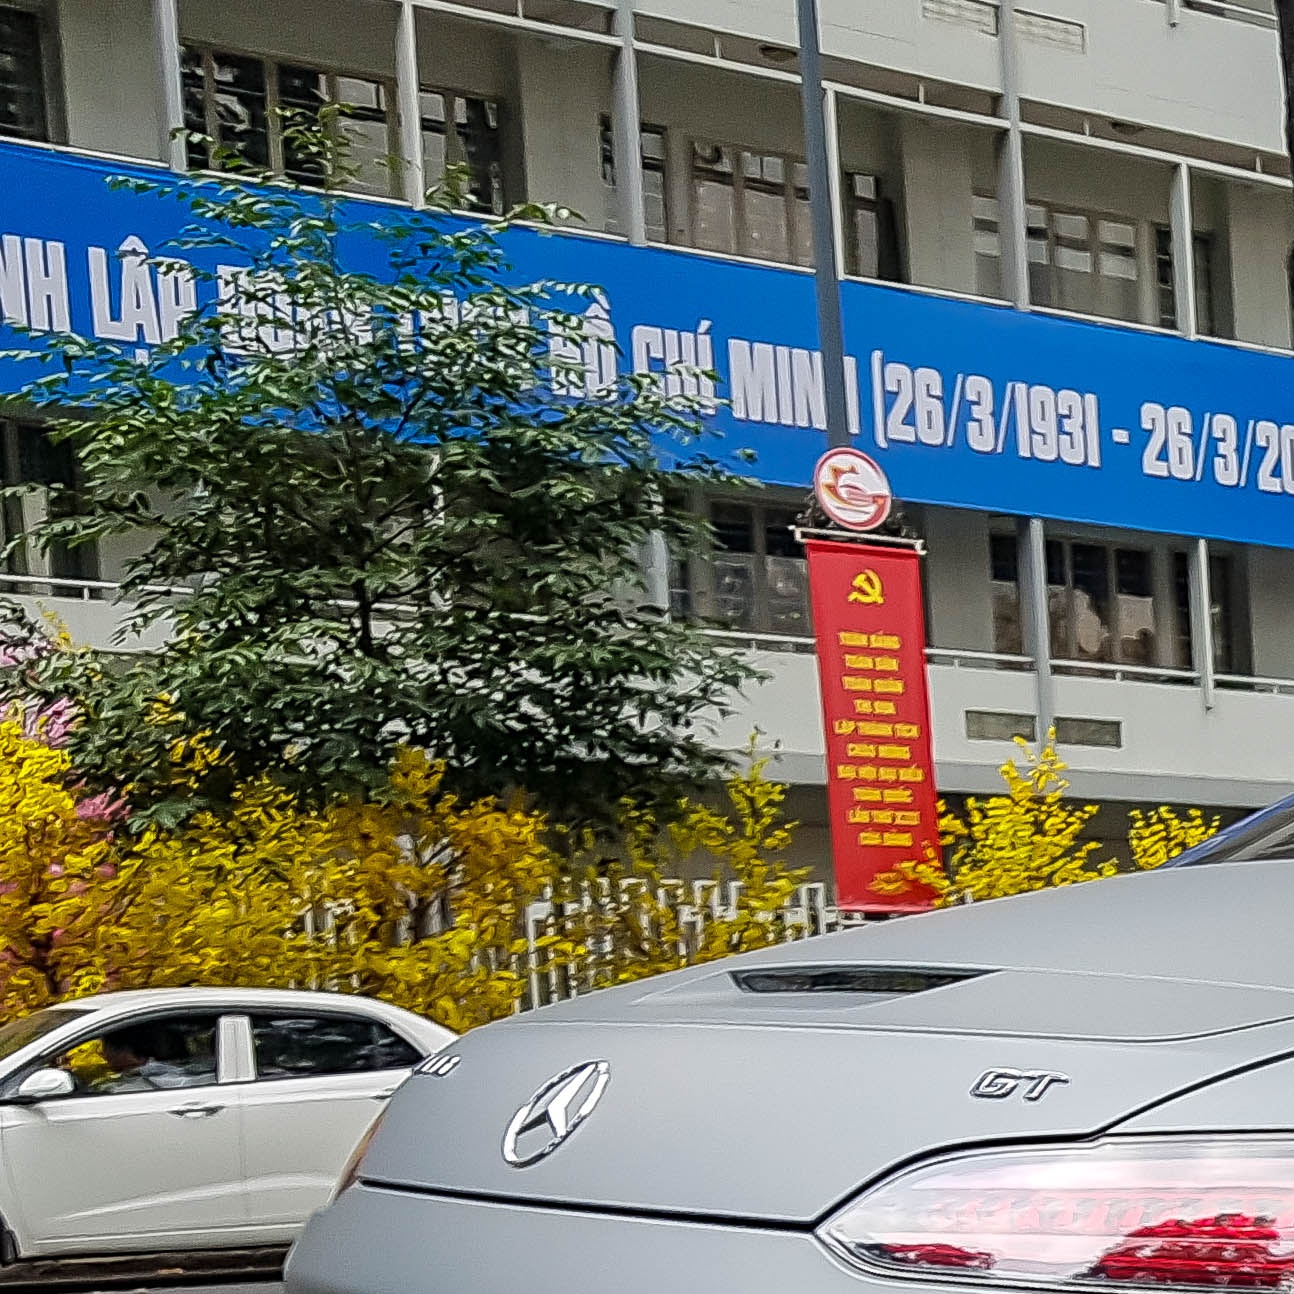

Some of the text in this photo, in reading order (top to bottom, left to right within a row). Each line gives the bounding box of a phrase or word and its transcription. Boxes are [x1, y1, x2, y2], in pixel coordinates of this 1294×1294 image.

[88, 235, 197, 366] LẬP
[871, 350, 1101, 467] (26/3/1931
[969, 1066, 1070, 1102] GT
